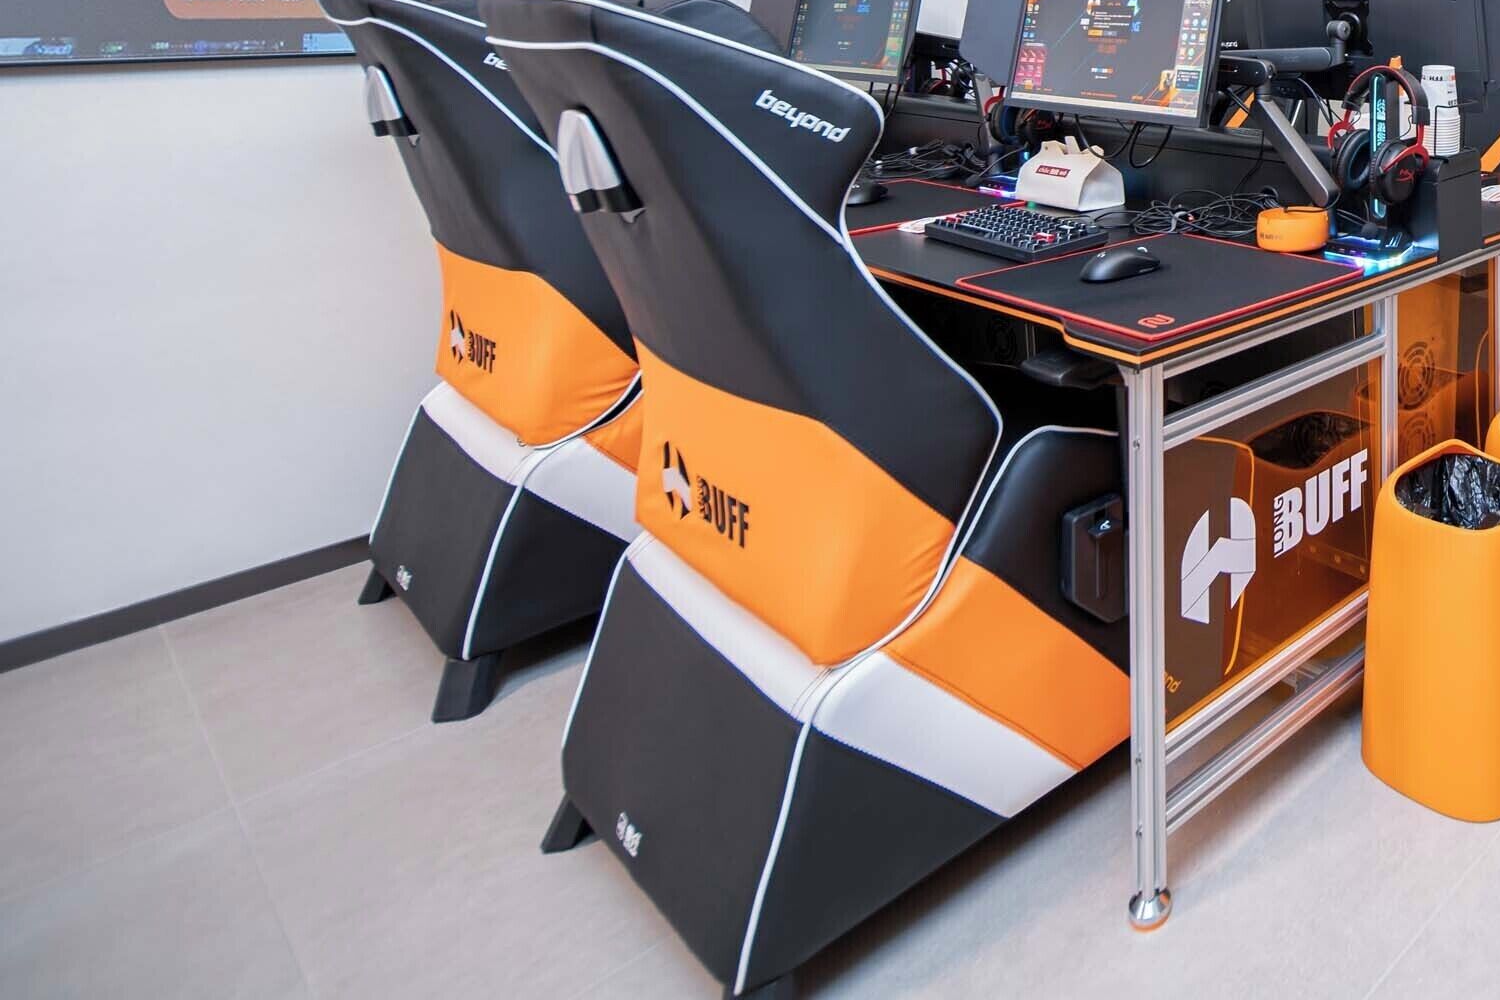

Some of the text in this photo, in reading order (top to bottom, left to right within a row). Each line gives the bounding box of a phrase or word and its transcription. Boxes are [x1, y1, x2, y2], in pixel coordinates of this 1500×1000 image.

[755, 88, 852, 144] beyond
[467, 328, 497, 374] BUFF
[698, 477, 750, 549] BUFF
[1272, 448, 1368, 559] BUFF
[1272, 496, 1285, 554] LONG
